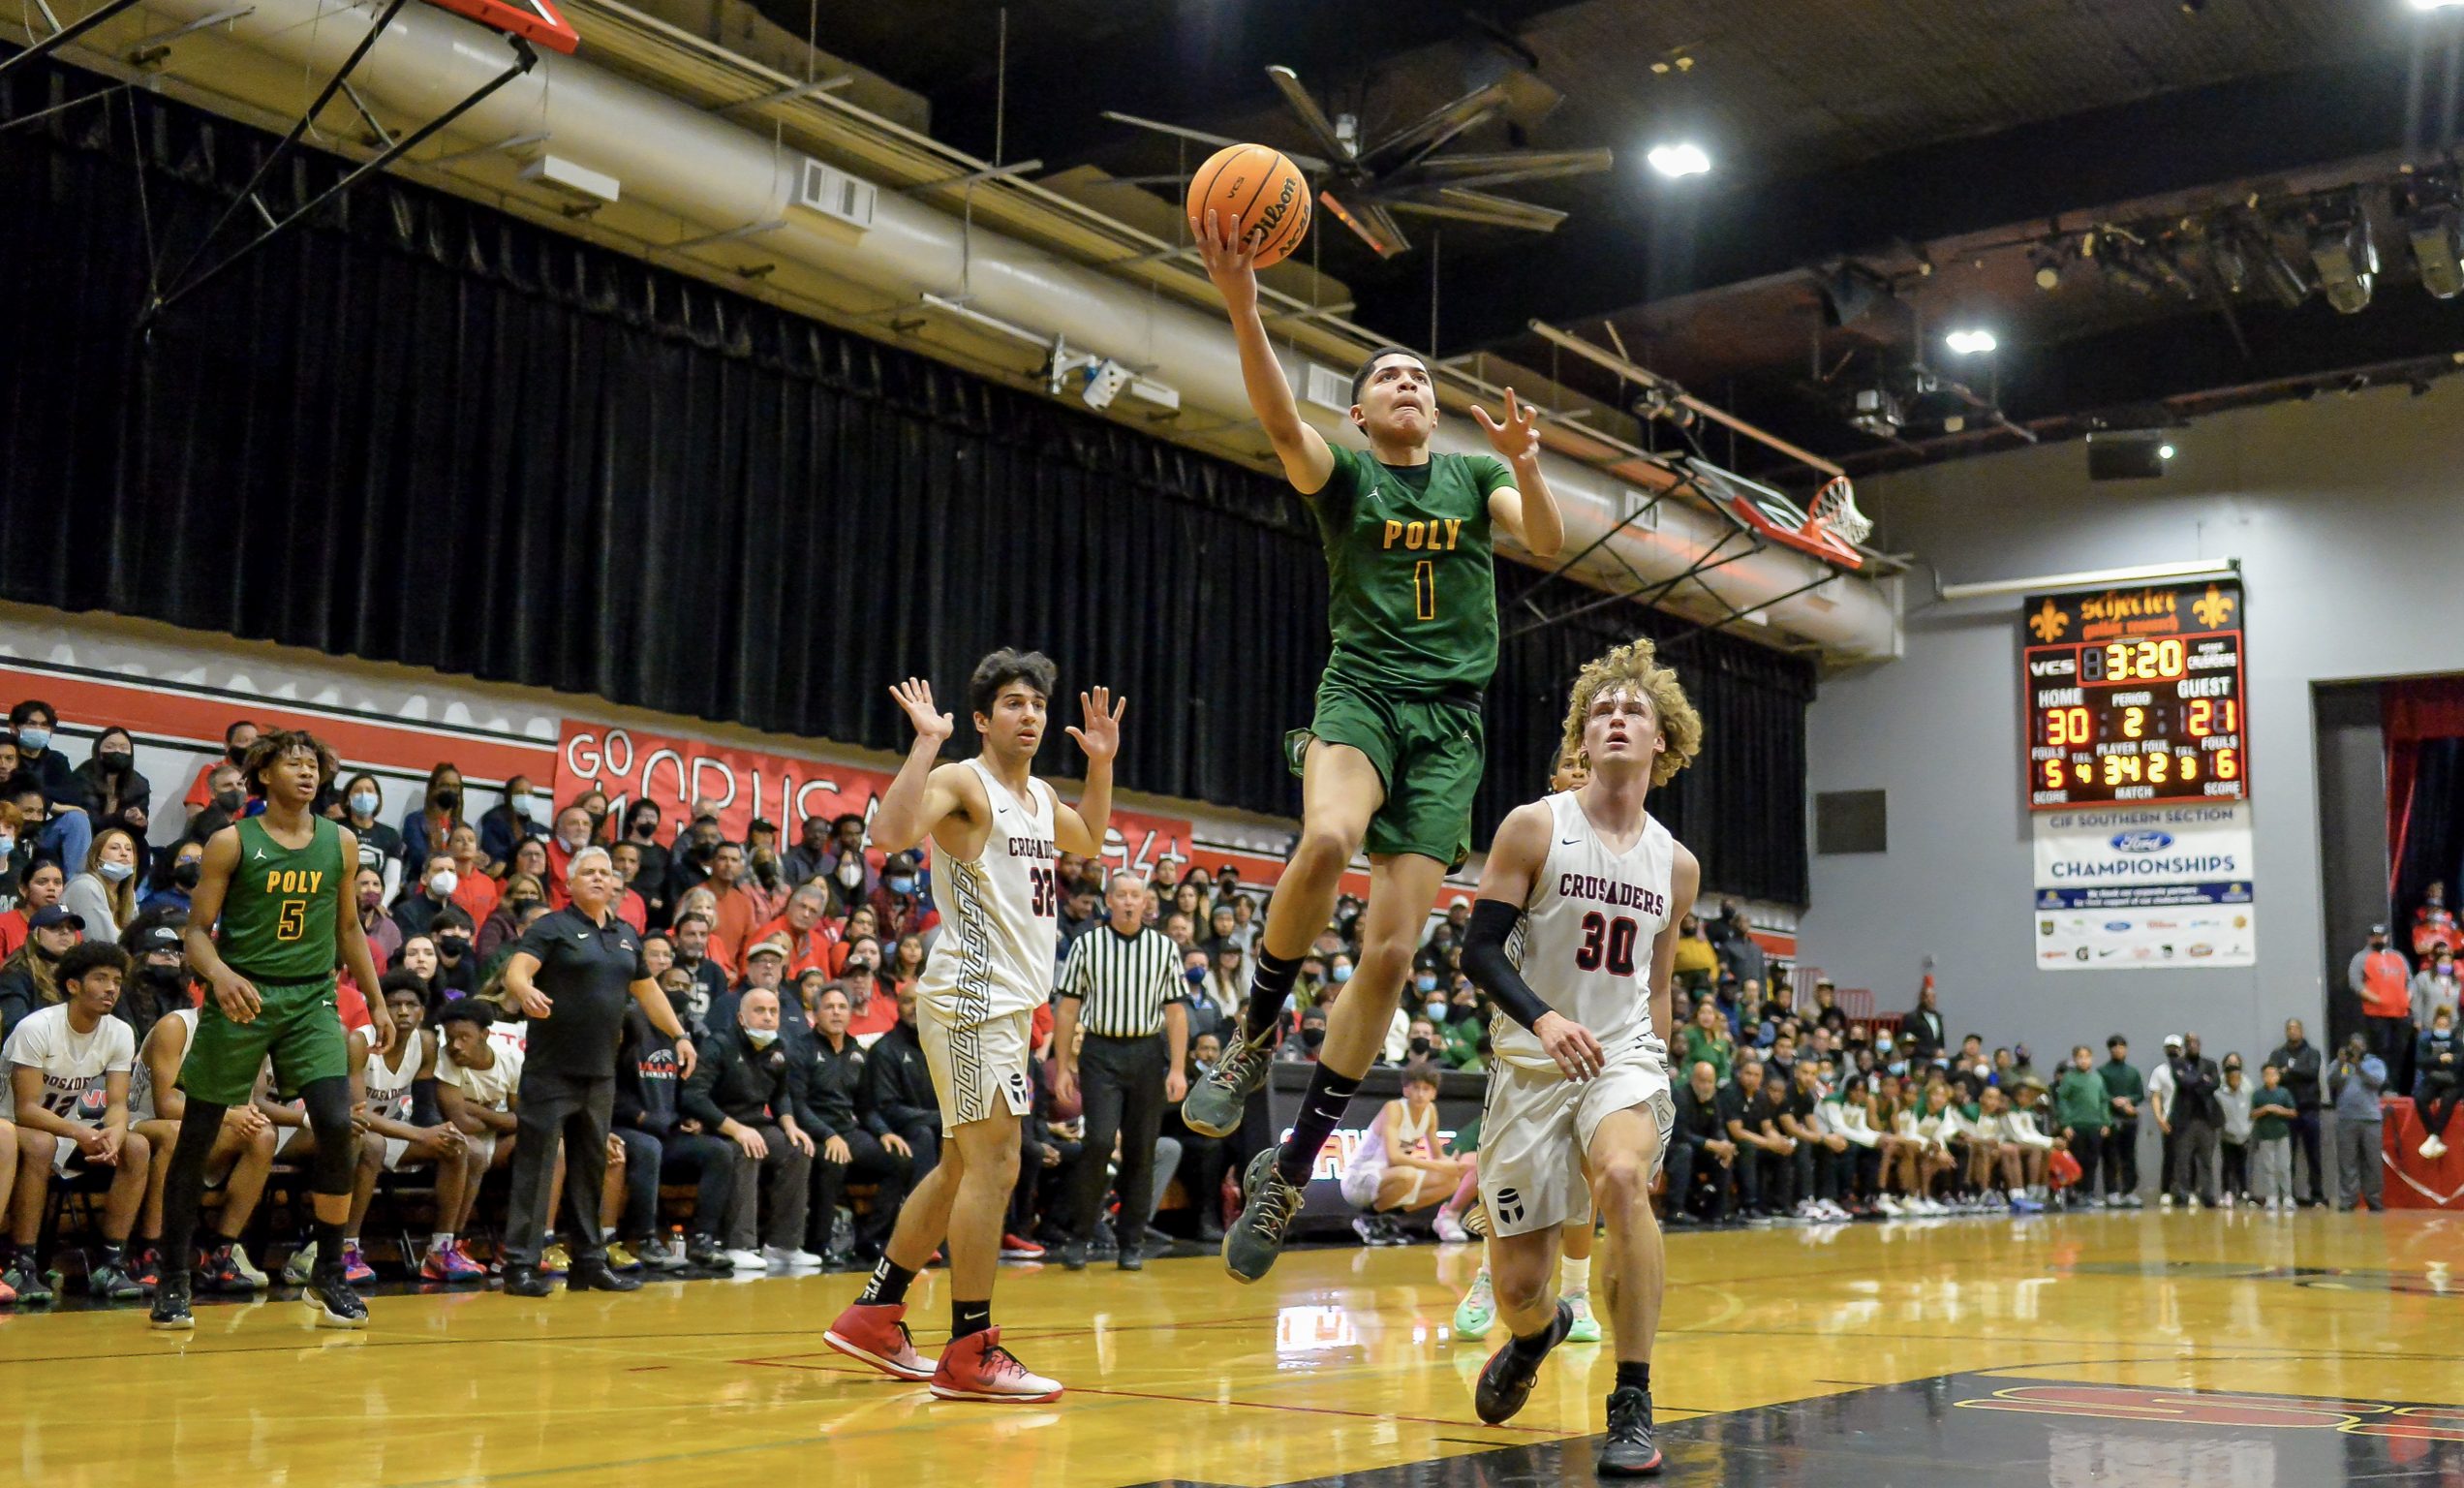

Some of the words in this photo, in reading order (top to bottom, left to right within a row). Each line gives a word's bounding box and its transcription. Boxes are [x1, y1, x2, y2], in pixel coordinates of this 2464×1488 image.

[1383, 519, 1462, 550] POLY
[1414, 561, 1434, 620] 1
[2030, 659, 2076, 676] VCS
[2107, 640, 2183, 681] 3:20
[2039, 688, 2083, 708] HOME
[2112, 692, 2152, 706] PERIOD
[2177, 676, 2232, 698] GUEST
[2047, 709, 2089, 745] 30
[2123, 707, 2143, 737] 2
[2189, 699, 2235, 736] 21
[567, 728, 633, 779] GO
[2032, 746, 2066, 760] FOULS
[2096, 741, 2138, 756] PLAYER
[2141, 739, 2170, 753] FOUL
[2202, 735, 2238, 750] FOULS
[2045, 759, 2063, 788] 5
[2076, 763, 2091, 784] 4
[2104, 755, 2141, 785] 34
[2147, 752, 2168, 783] 2
[2216, 749, 2236, 779] 6
[2033, 790, 2068, 804] SCORE
[2115, 786, 2154, 800] MATCH
[2203, 781, 2240, 796] SCORE
[2049, 816, 2074, 828] CIF
[2077, 812, 2160, 827] SOUTHERN
[2166, 808, 2233, 823] SECTION
[2119, 831, 2163, 852] Ford
[2051, 855, 2235, 878] CHAMPIONSHIPS
[266, 870, 323, 893] POLY
[1030, 867, 1055, 917] 32
[1559, 873, 1663, 916] CRUSADERS
[277, 899, 306, 940] 5
[1575, 910, 1639, 977] 30
